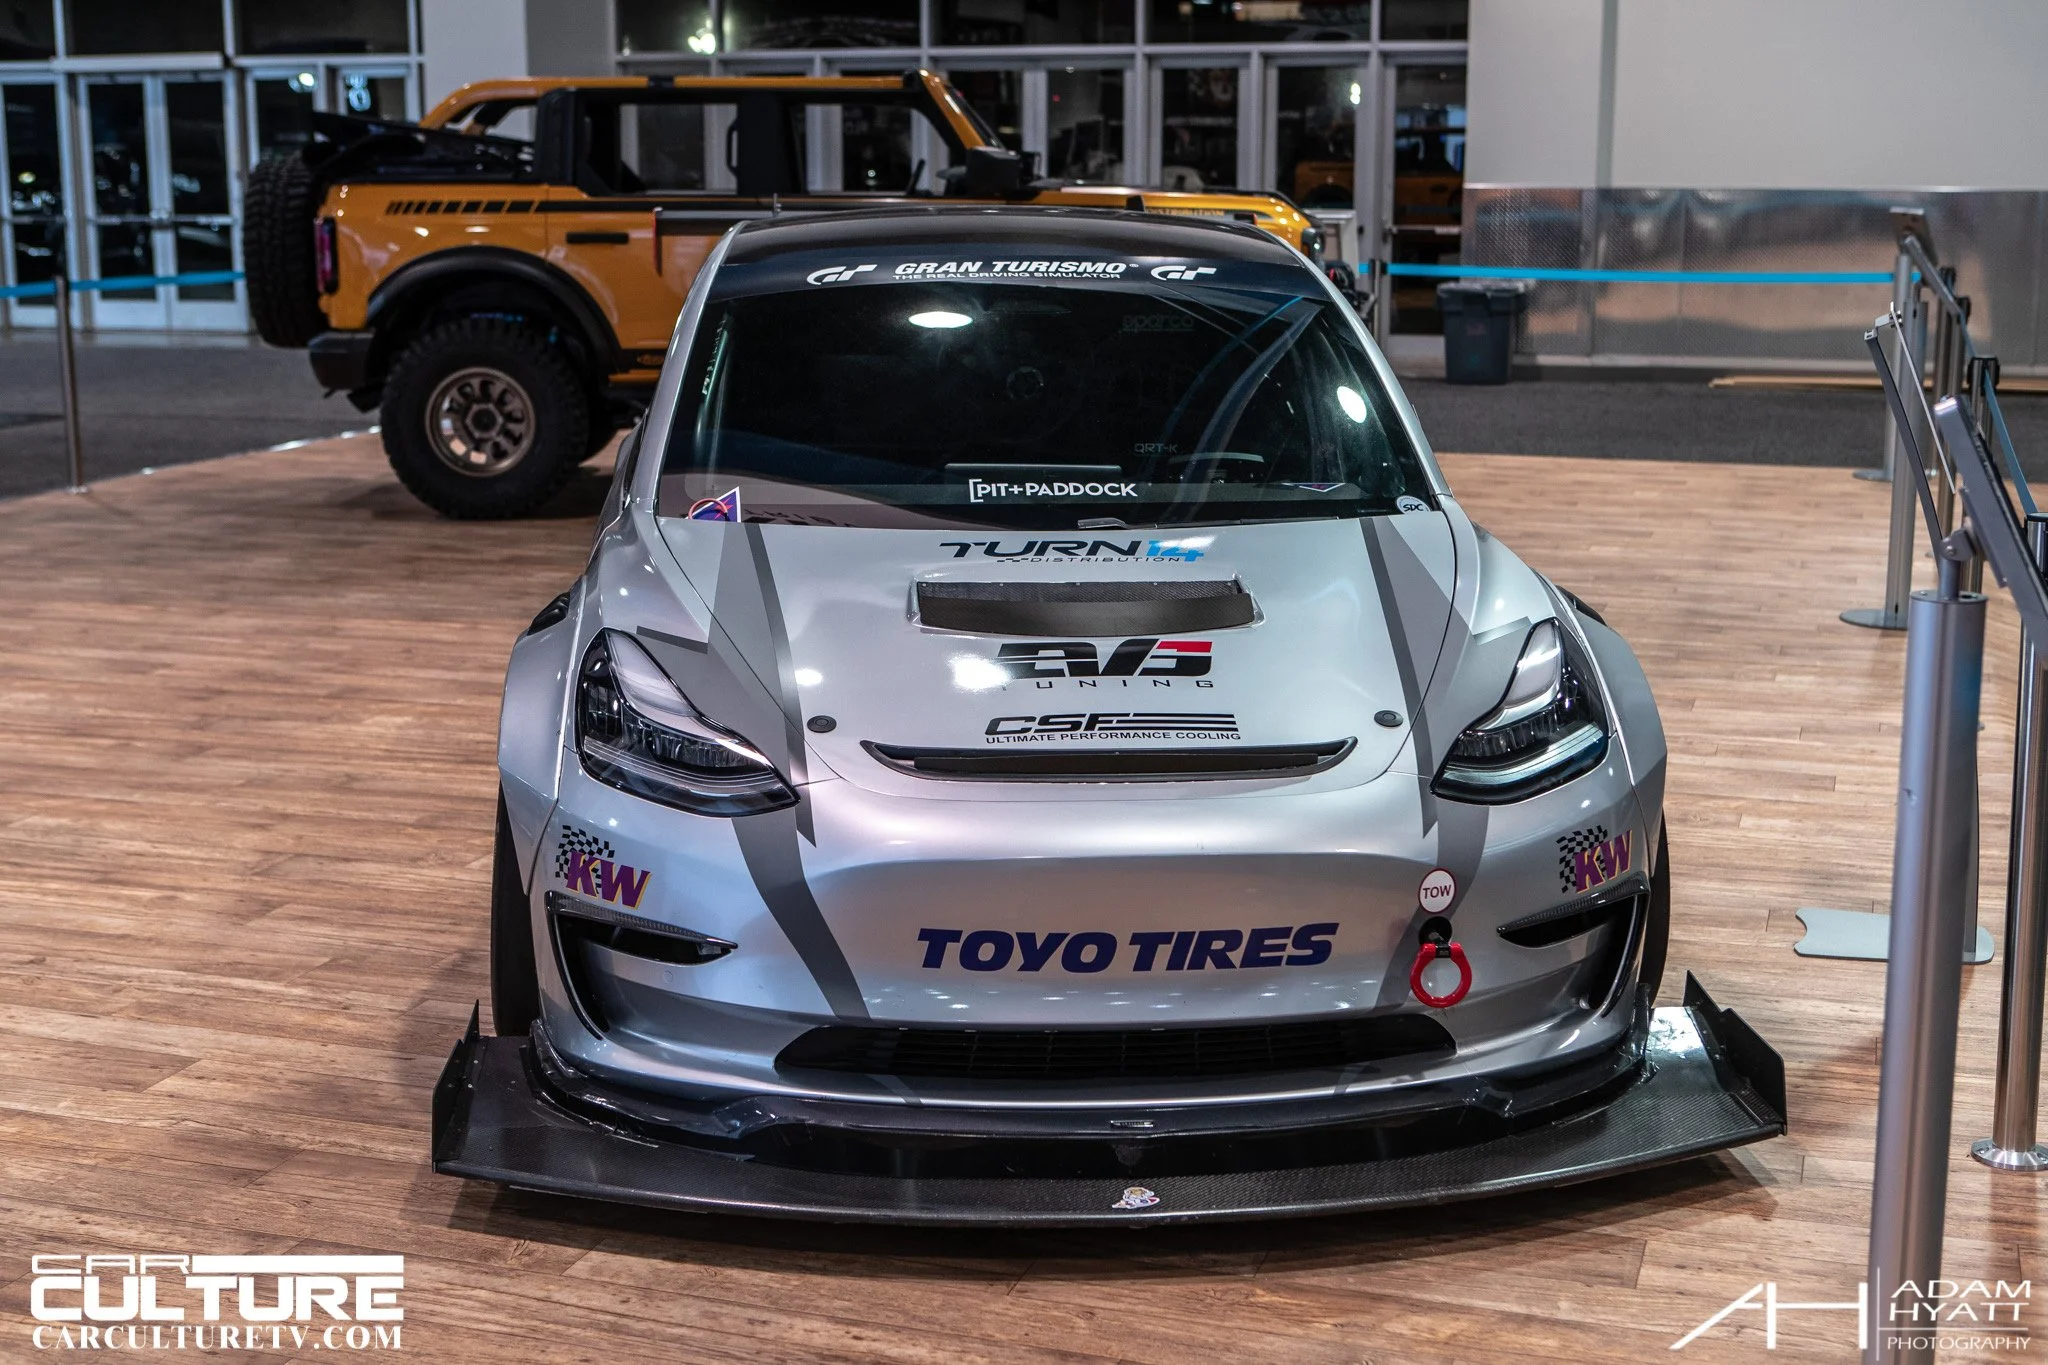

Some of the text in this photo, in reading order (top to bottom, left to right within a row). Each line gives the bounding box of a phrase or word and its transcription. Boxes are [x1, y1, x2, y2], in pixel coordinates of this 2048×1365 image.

[895, 261, 983, 275] GRAN
[1403, 503, 1424, 511] SDC
[984, 712, 1131, 736] CSF
[986, 731, 1241, 744] ULTIMATE PERFORMANCE COOLING
[1573, 828, 1633, 894] KW
[565, 849, 652, 911] KW
[1422, 884, 1452, 900] TOW
[916, 922, 1339, 974] TOYO TIRES
